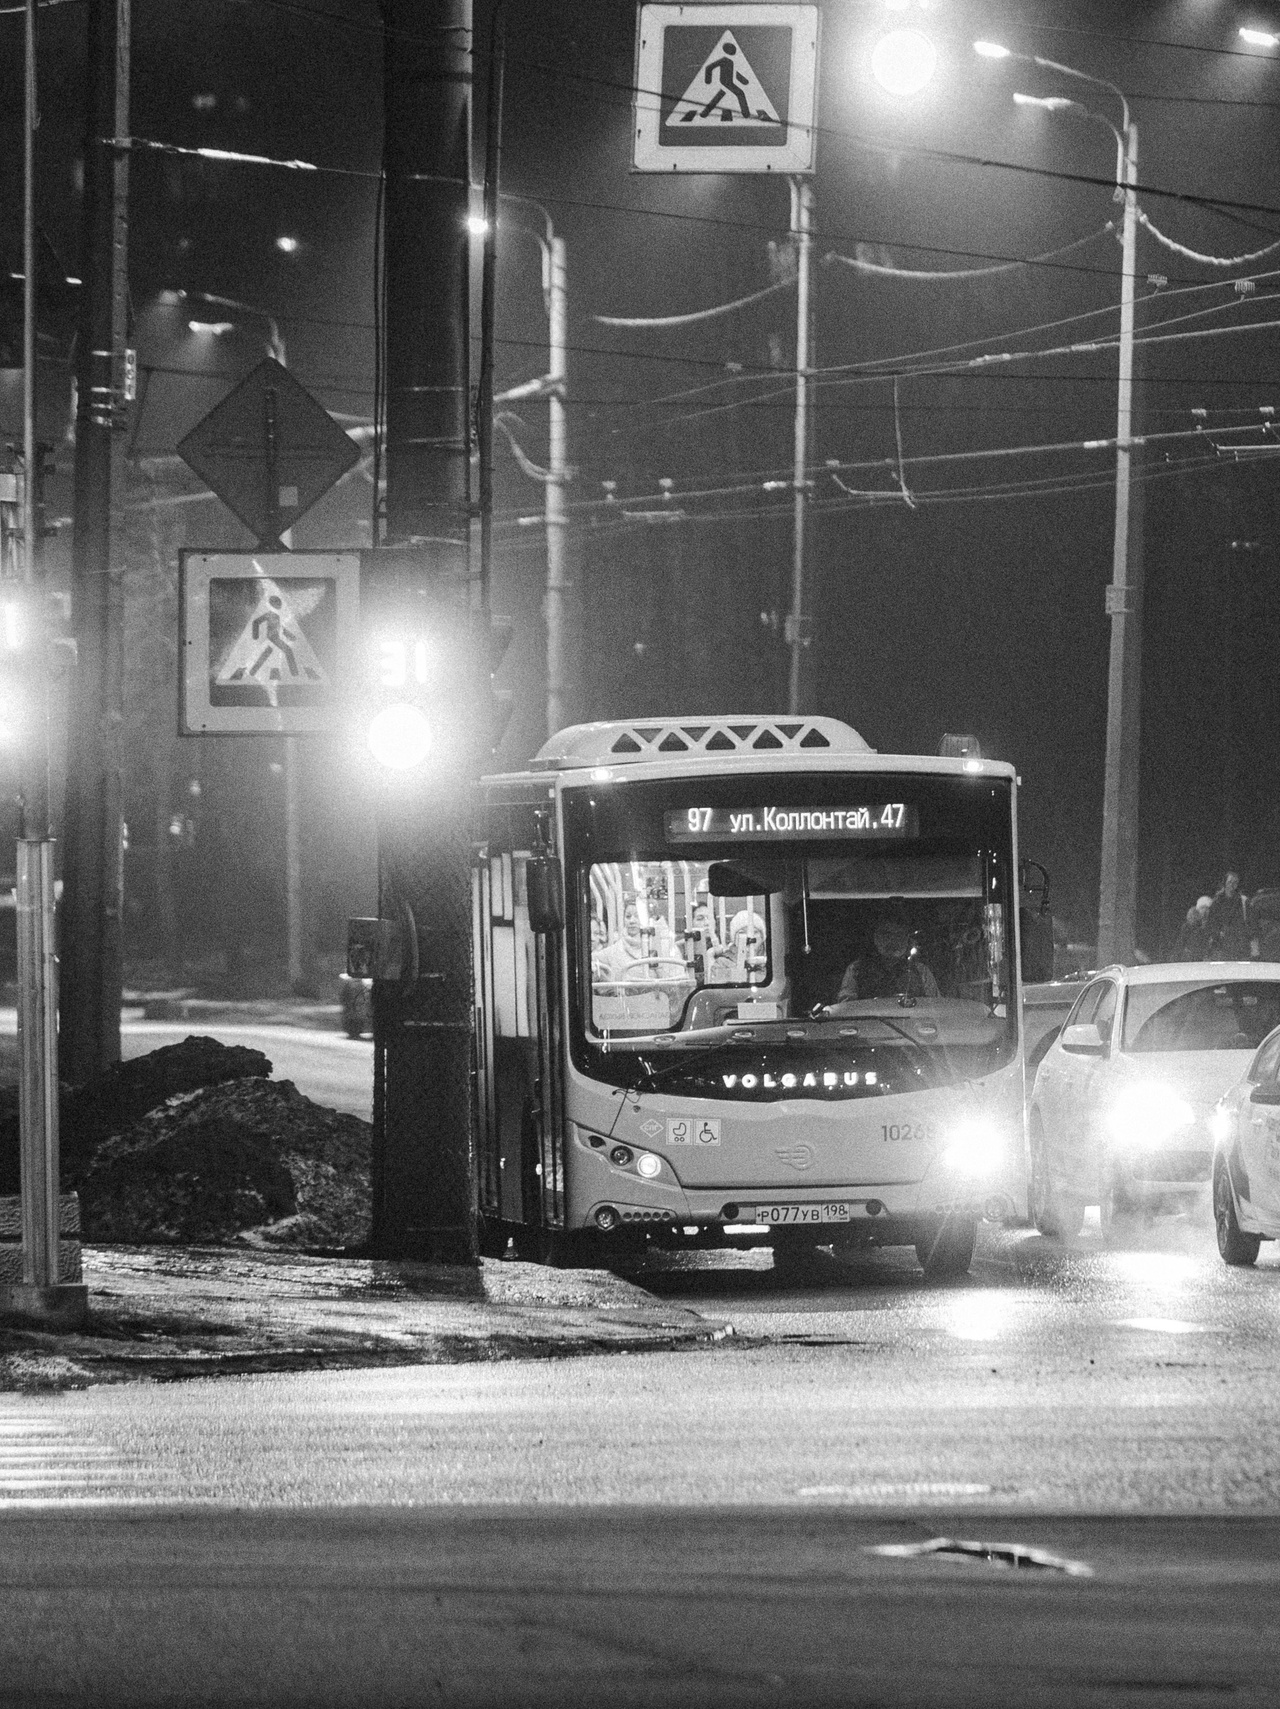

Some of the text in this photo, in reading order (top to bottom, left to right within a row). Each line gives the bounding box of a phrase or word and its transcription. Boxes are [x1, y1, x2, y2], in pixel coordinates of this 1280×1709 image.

[379, 640, 429, 687] 31
[687, 807, 713, 832] 97
[722, 1071, 878, 1089] VOLGABUS
